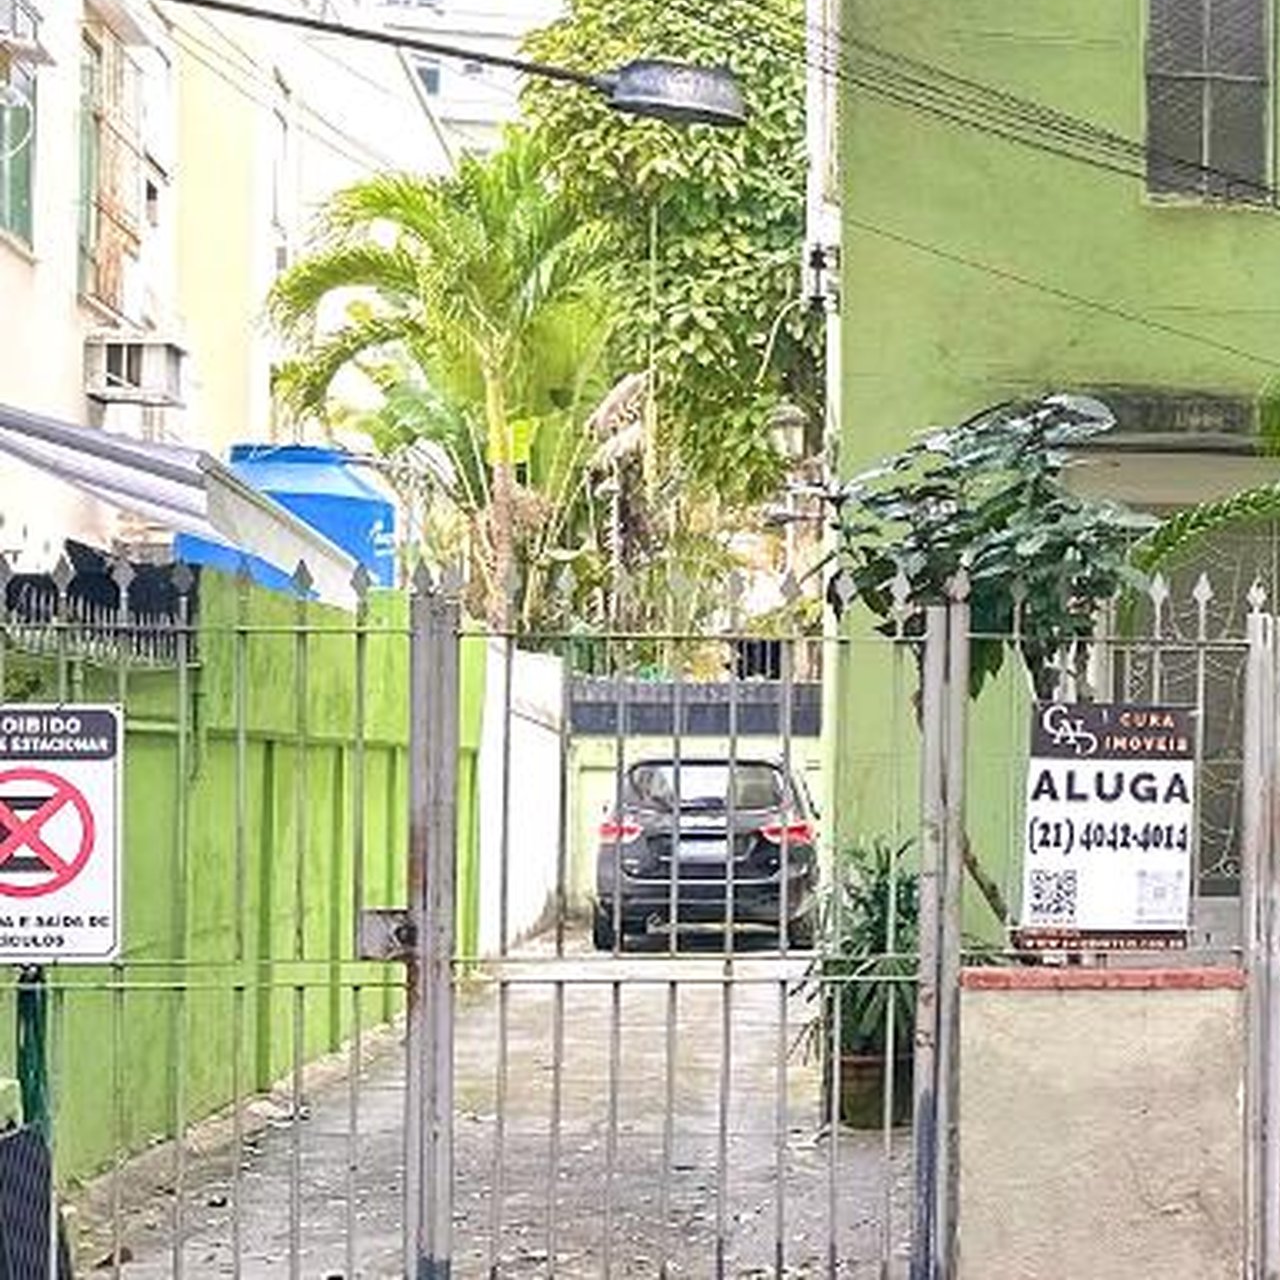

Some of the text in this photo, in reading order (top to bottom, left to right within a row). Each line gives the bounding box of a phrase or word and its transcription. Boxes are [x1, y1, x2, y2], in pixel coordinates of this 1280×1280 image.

[1031, 769, 1190, 804] ALUGA
[1029, 816, 1188, 856] (21) 4042-4014
